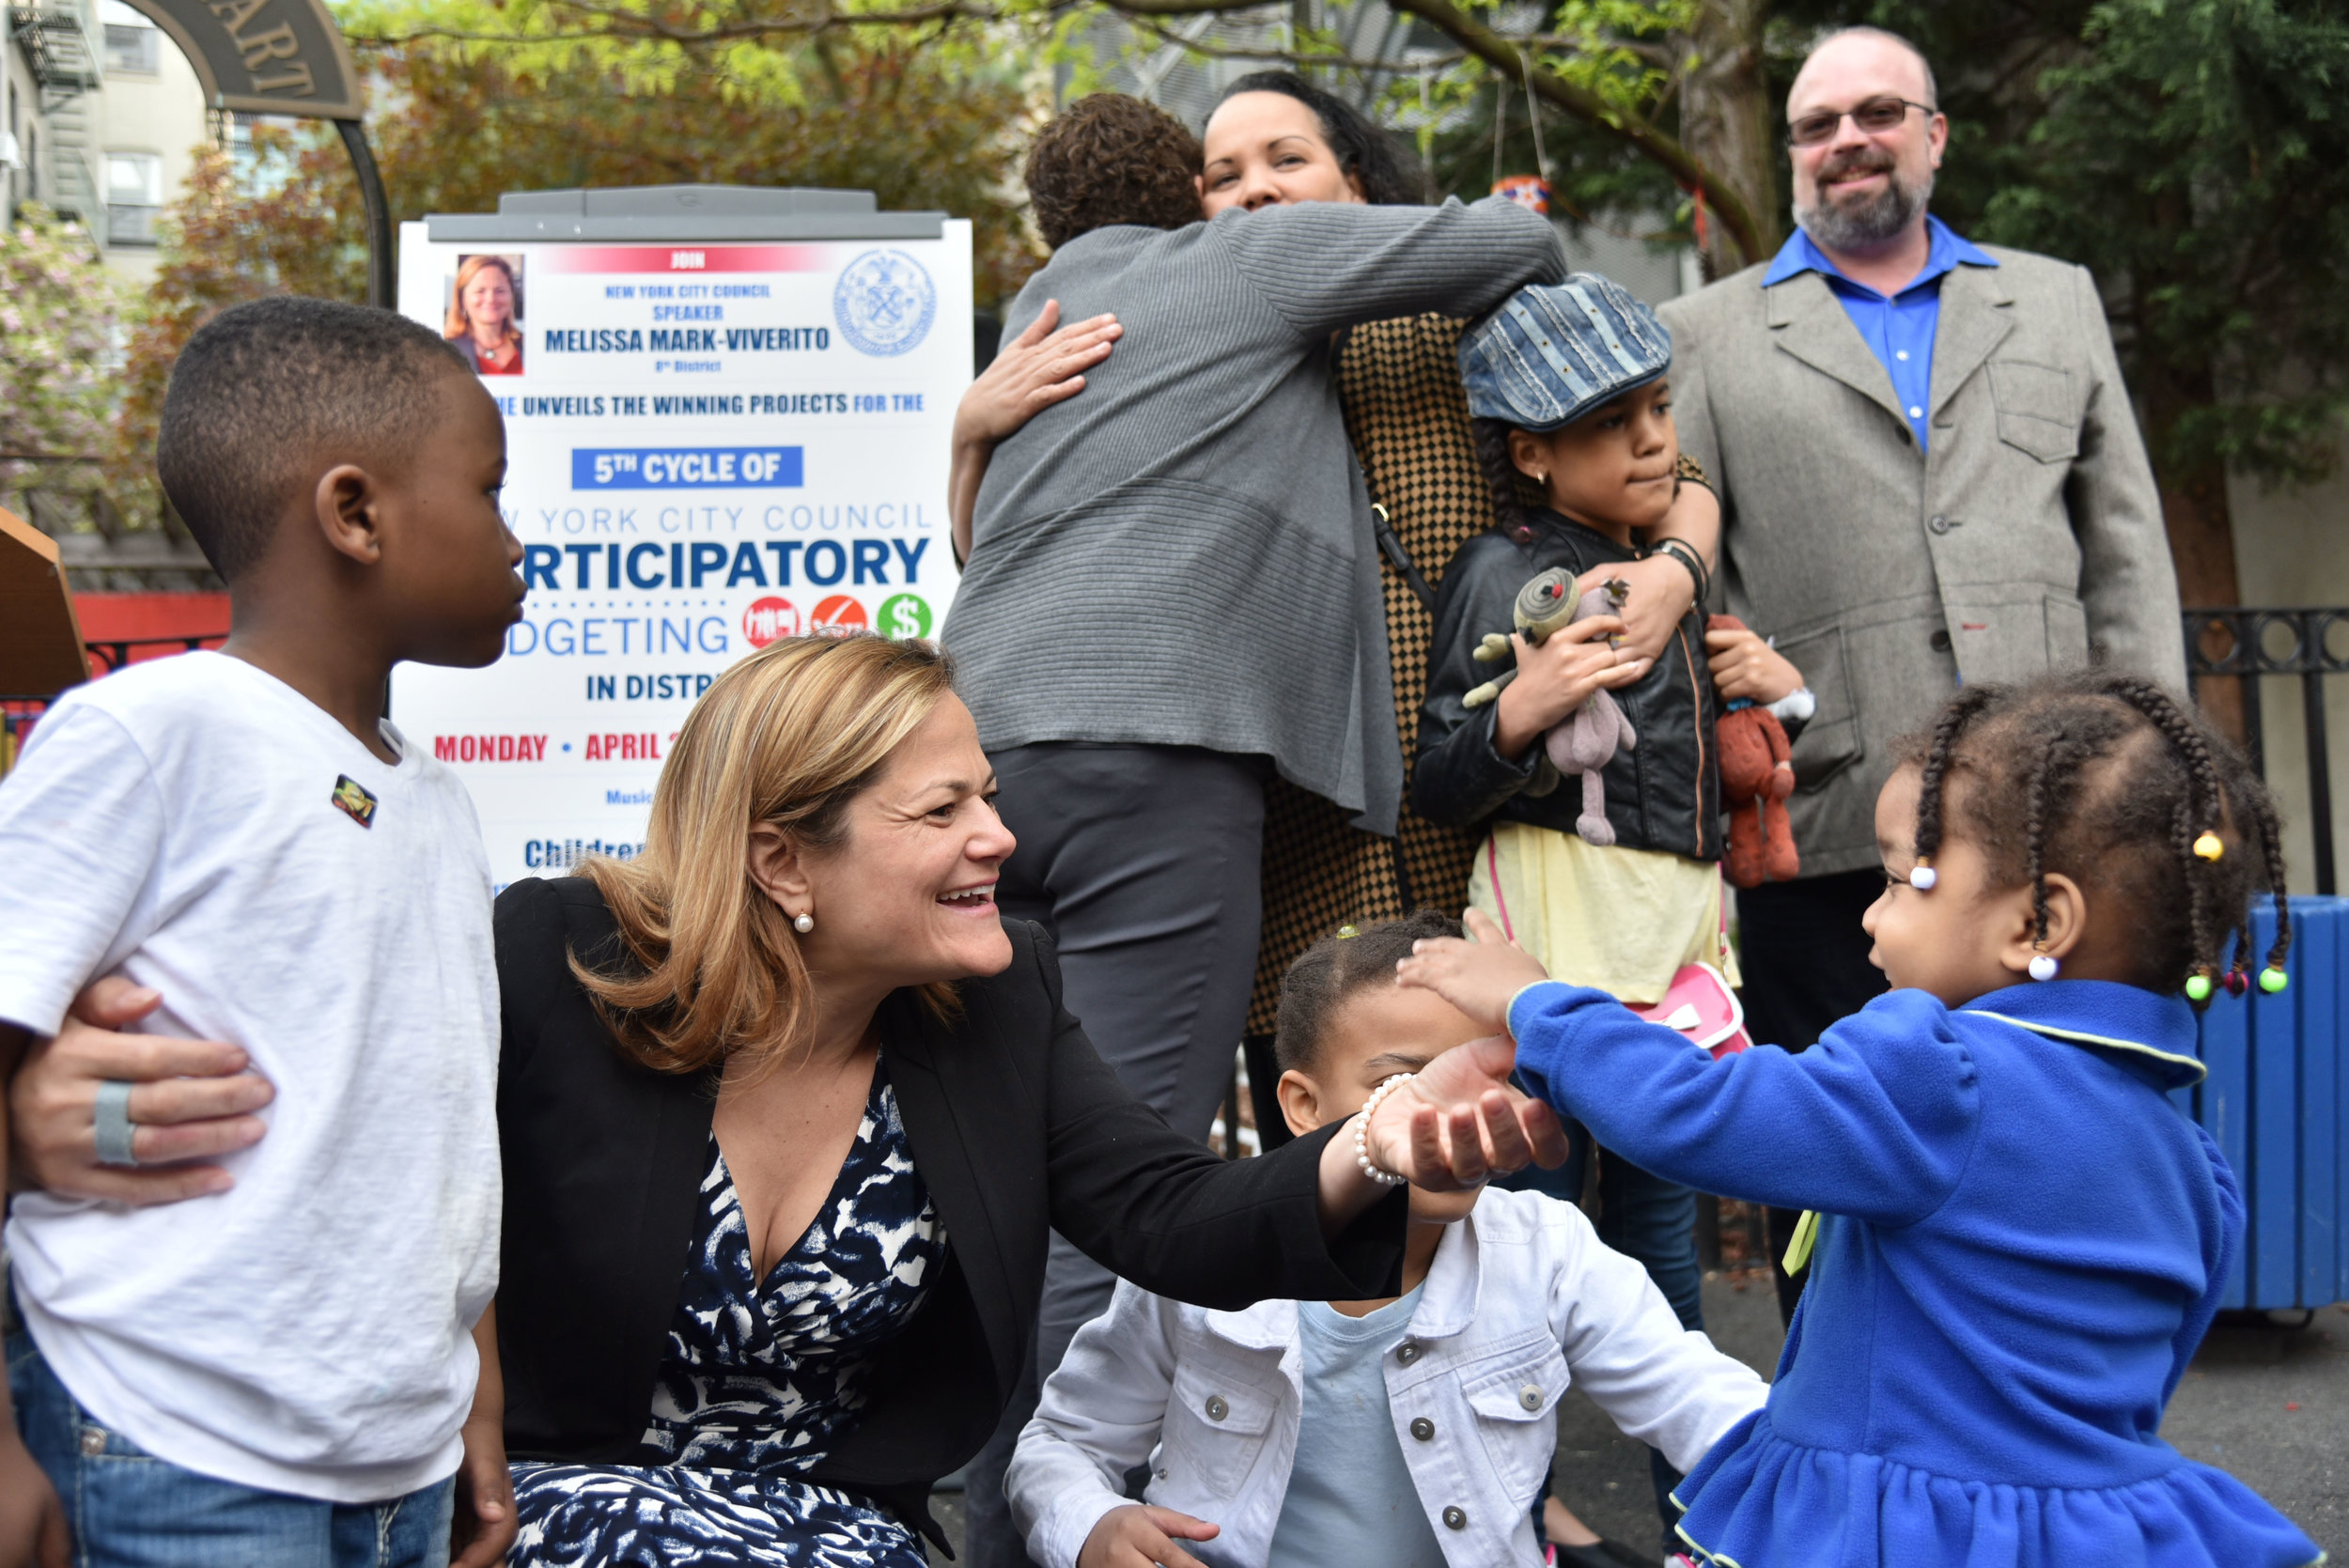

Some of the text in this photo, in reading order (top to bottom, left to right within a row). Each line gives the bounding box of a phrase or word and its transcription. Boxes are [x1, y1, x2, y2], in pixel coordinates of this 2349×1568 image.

[671, 251, 706, 270] JOIN
[605, 285, 770, 299] NEW YORK CITY COUNCIL
[653, 304, 724, 321] SPEAKER
[545, 327, 831, 352] MELISSA MARK-VIVERITO
[675, 360, 722, 373] District
[494, 394, 924, 416] HE UNVEILS THE WINNING PROJECTS FOR THE
[594, 452, 782, 484] 5TH CYCLE OF
[540, 507, 639, 535] YORK
[660, 506, 743, 534] CITY
[763, 504, 932, 532] COUNCIL
[523, 537, 930, 591] RTICIPATORY
[508, 615, 729, 656] DGETING
[586, 674, 720, 700] IN DISTR
[434, 733, 662, 763] MONDAY APRIL
[606, 789, 653, 805] Music
